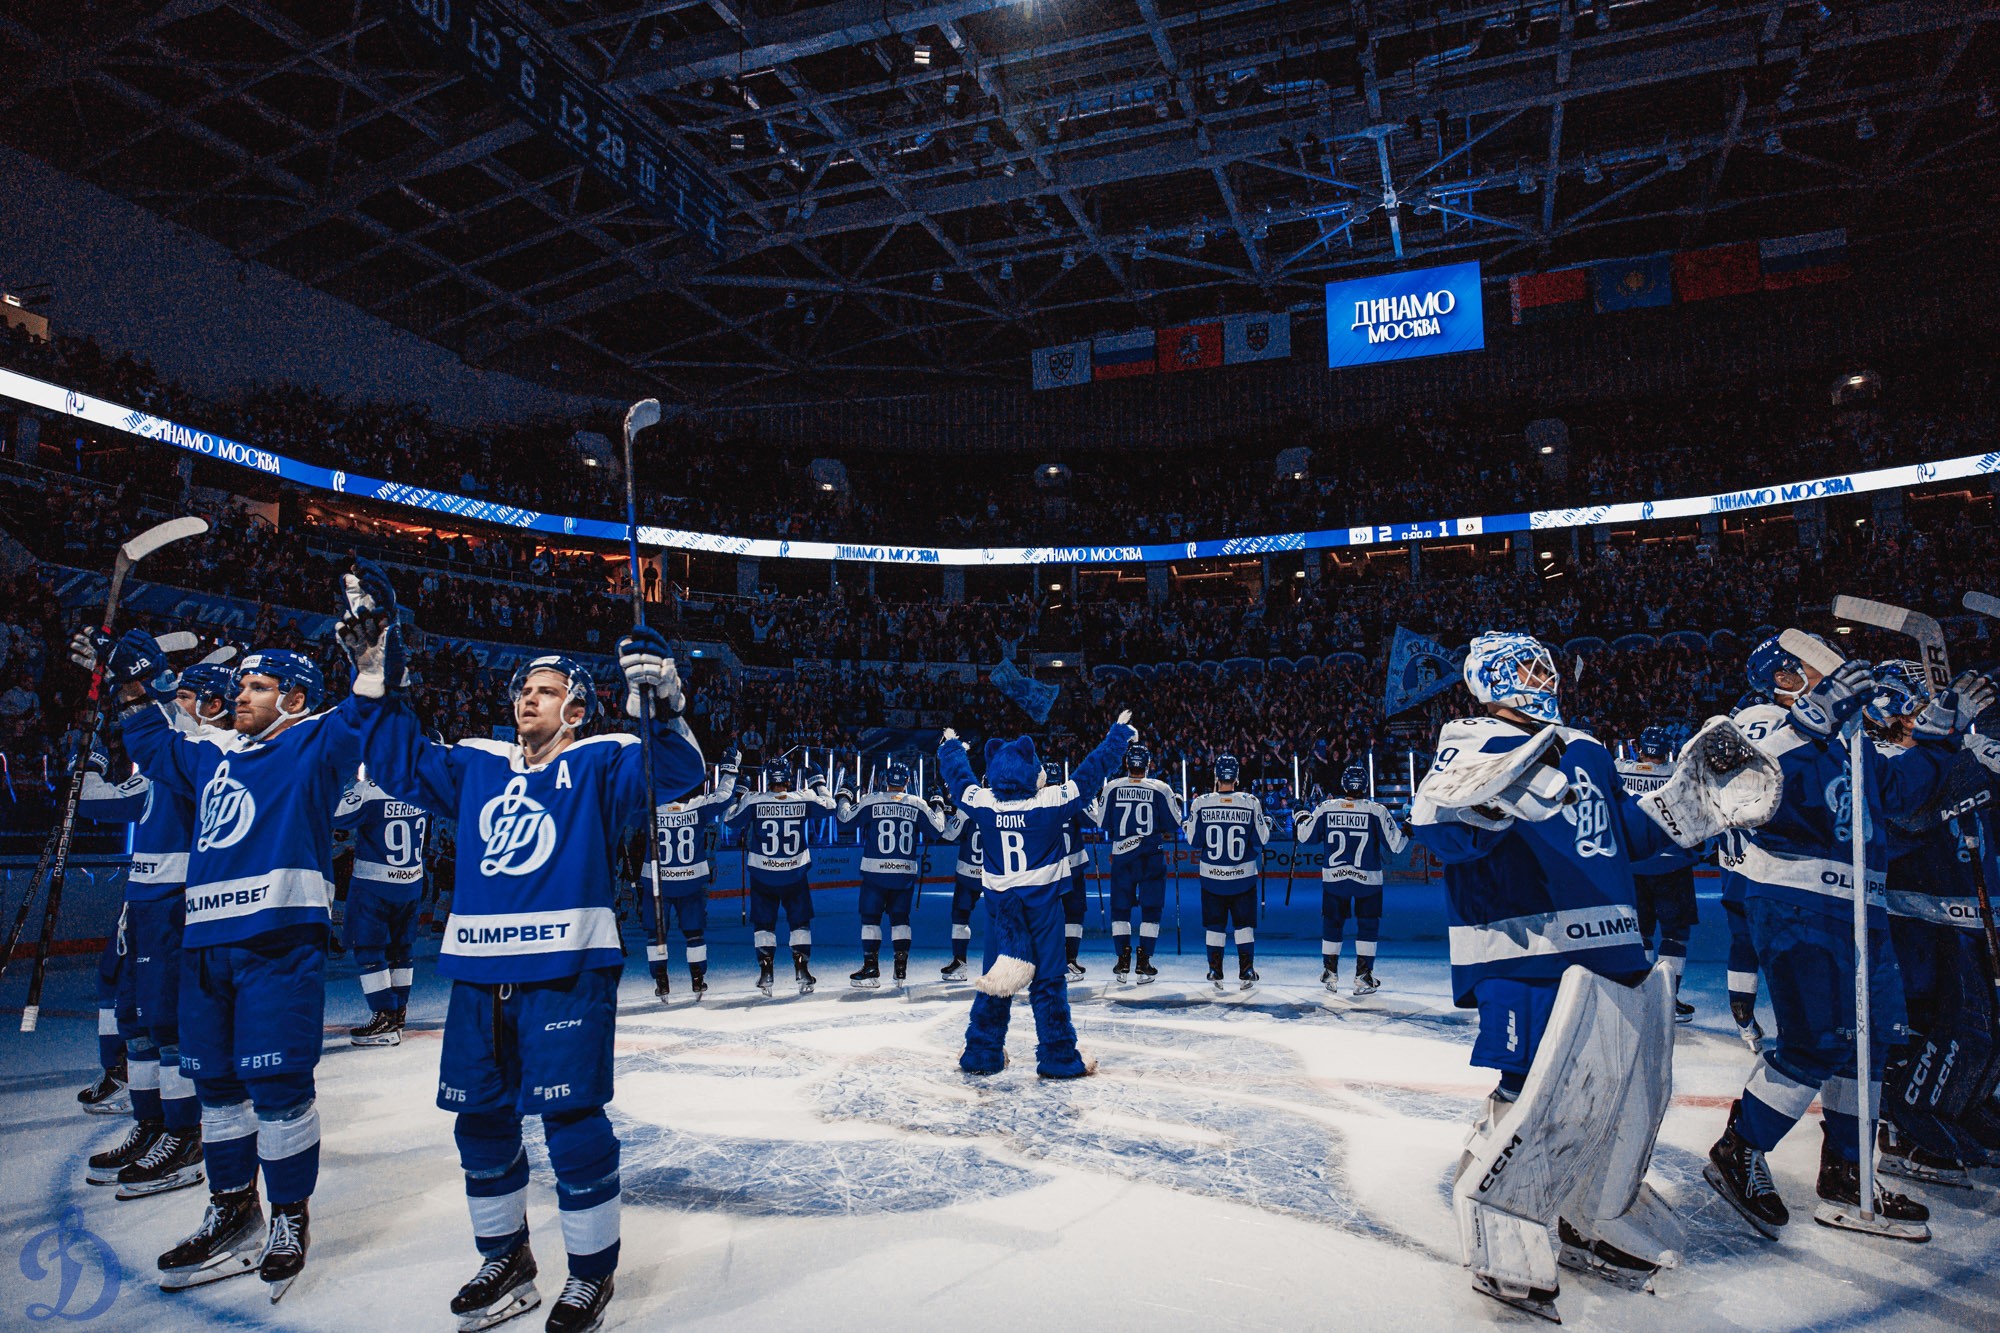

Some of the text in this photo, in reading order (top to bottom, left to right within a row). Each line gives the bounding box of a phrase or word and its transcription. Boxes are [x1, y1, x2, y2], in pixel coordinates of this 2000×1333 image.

[1351, 289, 1456, 331] ДИНАМО
[1368, 317, 1441, 344] МОСКВА
[218, 439, 281, 474] МОСКВА
[1781, 476, 1855, 501] МОСКВА
[1379, 526, 1393, 542] 2
[1401, 530, 1432, 540] 0:00.0
[1438, 521, 1450, 537] 1
[1090, 547, 1143, 561] МОСКВА
[1647, 746, 1656, 755] 92
[555, 760, 572, 789] A
[1118, 789, 1152, 801] NIKONOV
[1941, 790, 1992, 822] CCM
[995, 814, 1027, 829] ВОЛК
[1115, 802, 1154, 837] 79
[1202, 809, 1251, 822] SHARAKANOV
[1328, 815, 1366, 827] MELIKOV
[1654, 797, 1682, 836] CCM
[384, 817, 427, 866] 93
[761, 819, 801, 856] 35
[877, 819, 914, 855] 88
[1205, 825, 1246, 861] 96
[1327, 830, 1370, 867] 27
[186, 884, 271, 914] OLIMPBET
[457, 923, 571, 944] OLIMPBET
[544, 1019, 582, 1031] CCM
[180, 1055, 201, 1071] ВТБ
[252, 1052, 283, 1069] ВТБ
[1904, 1040, 1938, 1105] CCM
[1929, 1039, 1960, 1106] CCM
[445, 1086, 466, 1102] ВТБ
[544, 1084, 571, 1101] ВТБ
[1479, 1134, 1523, 1193] CCM
